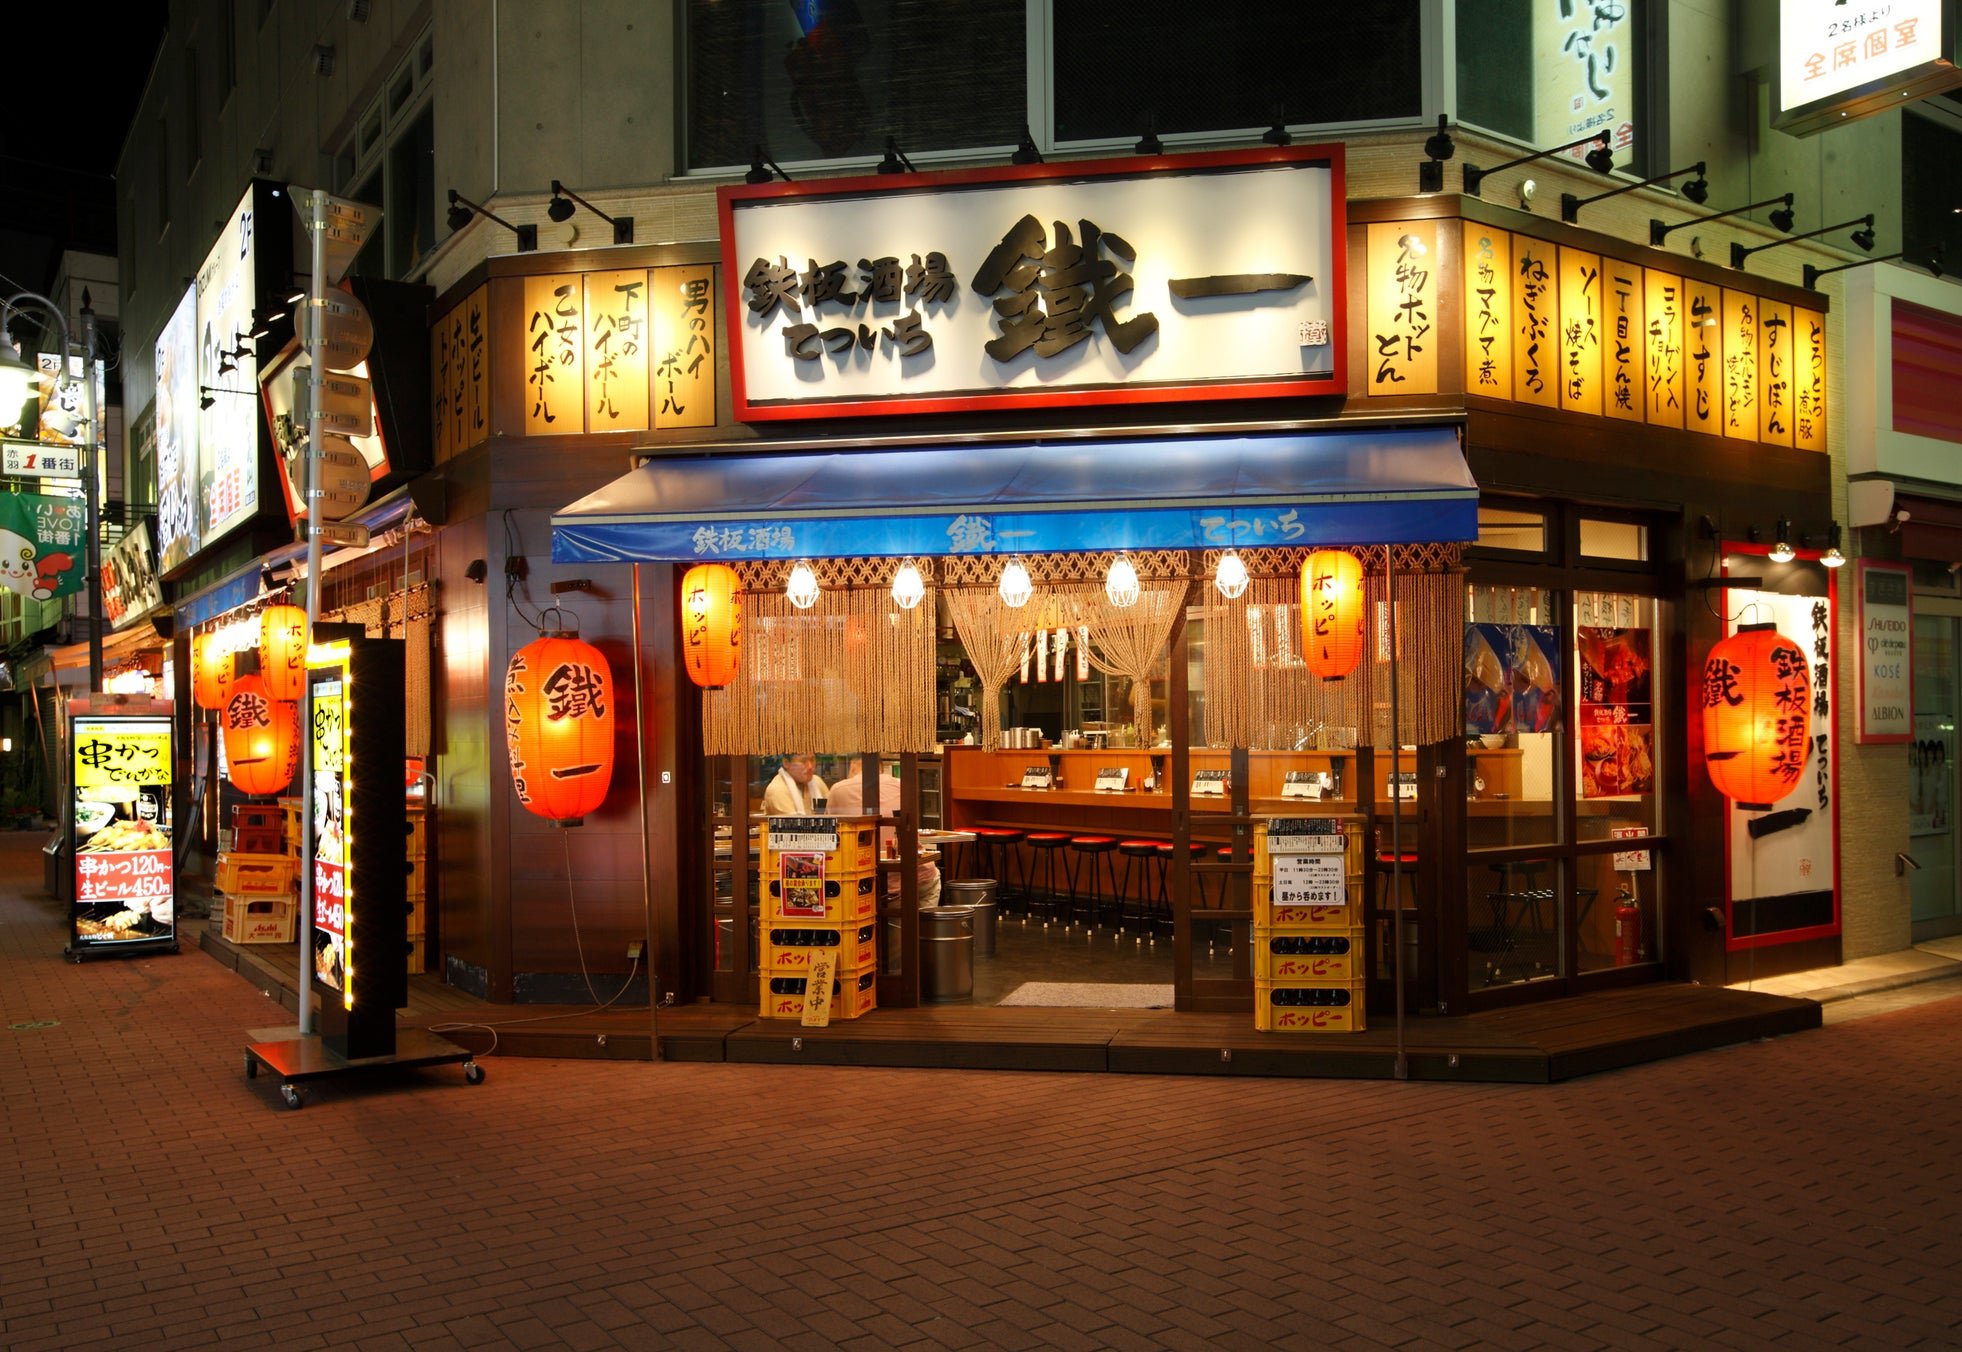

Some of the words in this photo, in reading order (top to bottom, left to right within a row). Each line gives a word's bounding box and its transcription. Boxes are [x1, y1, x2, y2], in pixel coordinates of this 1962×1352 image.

[1803, 16, 1919, 81] 全席個室
[554, 284, 578, 366] 乙女の
[614, 281, 644, 356] 下町の
[742, 250, 956, 319] 鉄板酒場
[972, 213, 1313, 364] 鐵一
[1394, 232, 1430, 361] 名物ホット
[1520, 250, 1549, 394] ねぎぶくろ
[1579, 265, 1598, 345] ソース
[470, 304, 484, 430] 生ビール
[529, 311, 556, 423] ハイボール
[593, 312, 620, 420] ハイボール
[680, 278, 712, 380] 男のハイ
[781, 309, 934, 363] てついち
[1375, 333, 1406, 384] とん
[1565, 317, 1585, 401] 焼そば
[1691, 296, 1718, 420] 牛すじ
[452, 317, 466, 444] ホッピー
[657, 352, 685, 416] ボール
[1764, 313, 1788, 435] すじぽん
[692, 525, 796, 556] 鉄板酒場
[1199, 509, 1305, 542] てついち
[286, 624, 303, 687] ホッピー
[688, 585, 707, 669] ホッピー
[1312, 572, 1336, 661] ホッピー
[1868, 617, 1907, 632] SHISEIDO
[1811, 600, 1829, 720] 鉄板酒場
[1873, 662, 1901, 679] KOSÉ
[227, 692, 271, 766] 鐵一
[543, 664, 605, 779] 鐵一
[1770, 645, 1809, 785] 鉄板酒場
[1872, 706, 1905, 721] ALBION
[78, 739, 159, 769] 串かつ
[1814, 734, 1829, 811] てついち
[80, 876, 170, 899] 生ビール450円
[1276, 905, 1341, 923] ホッピー
[810, 961, 830, 1011] 営業中
[1278, 958, 1343, 976] ホッピー
[1278, 1010, 1343, 1027] ホッピー
